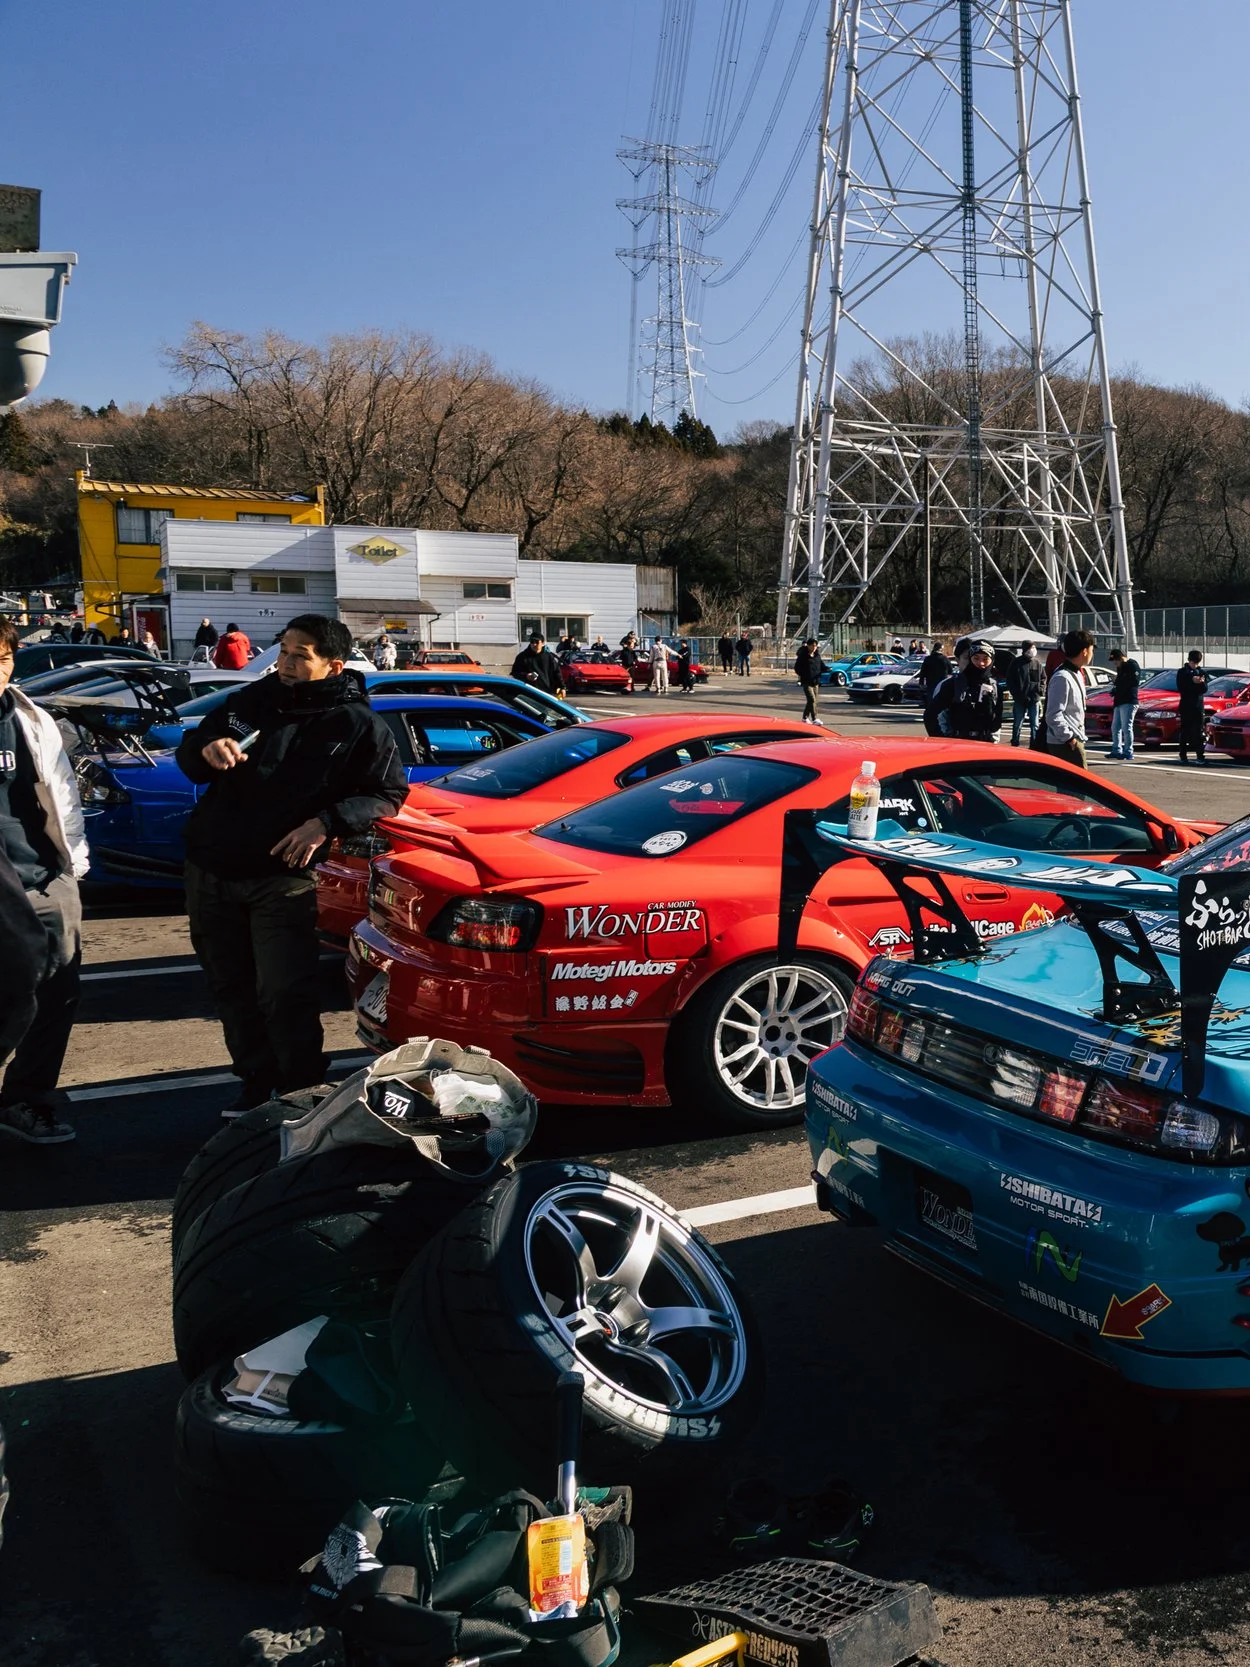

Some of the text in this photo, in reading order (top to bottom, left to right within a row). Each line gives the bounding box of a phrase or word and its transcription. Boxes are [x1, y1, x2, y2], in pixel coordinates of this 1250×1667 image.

[358, 544, 398, 557] Toilet
[648, 900, 697, 910] CAR MODIFY
[564, 904, 702, 940] WONDER
[1196, 929, 1224, 951] SHOT
[1224, 925, 1244, 945] BAR
[551, 959, 678, 982] Motegi Motors
[892, 980, 916, 997] OUT
[814, 1083, 854, 1119] SHIBATA
[1006, 1175, 1093, 1218] SHIBATA
[1010, 1196, 1087, 1227] MOTOR SPORT
